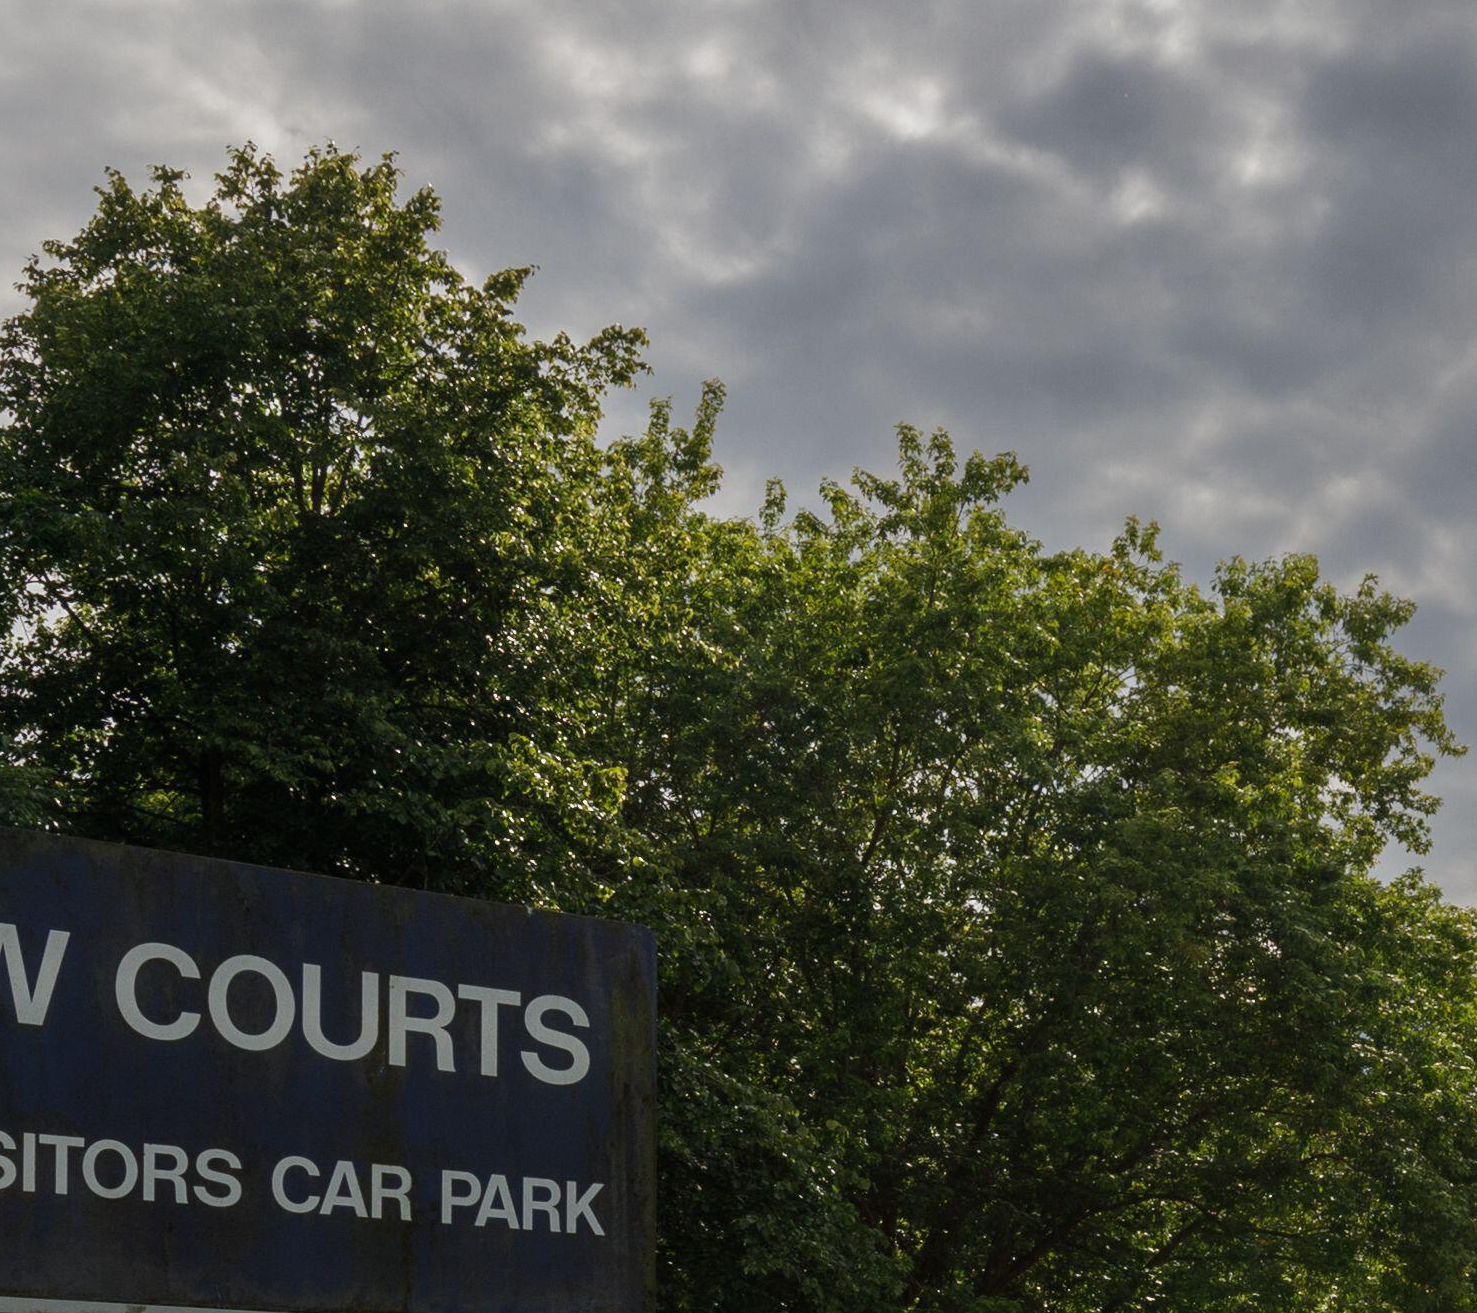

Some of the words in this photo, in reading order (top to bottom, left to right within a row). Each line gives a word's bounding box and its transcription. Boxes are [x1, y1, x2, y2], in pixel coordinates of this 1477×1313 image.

[115, 942, 591, 1085] COURTS
[271, 1155, 412, 1221] CAR
[441, 1169, 605, 1236] PARK
